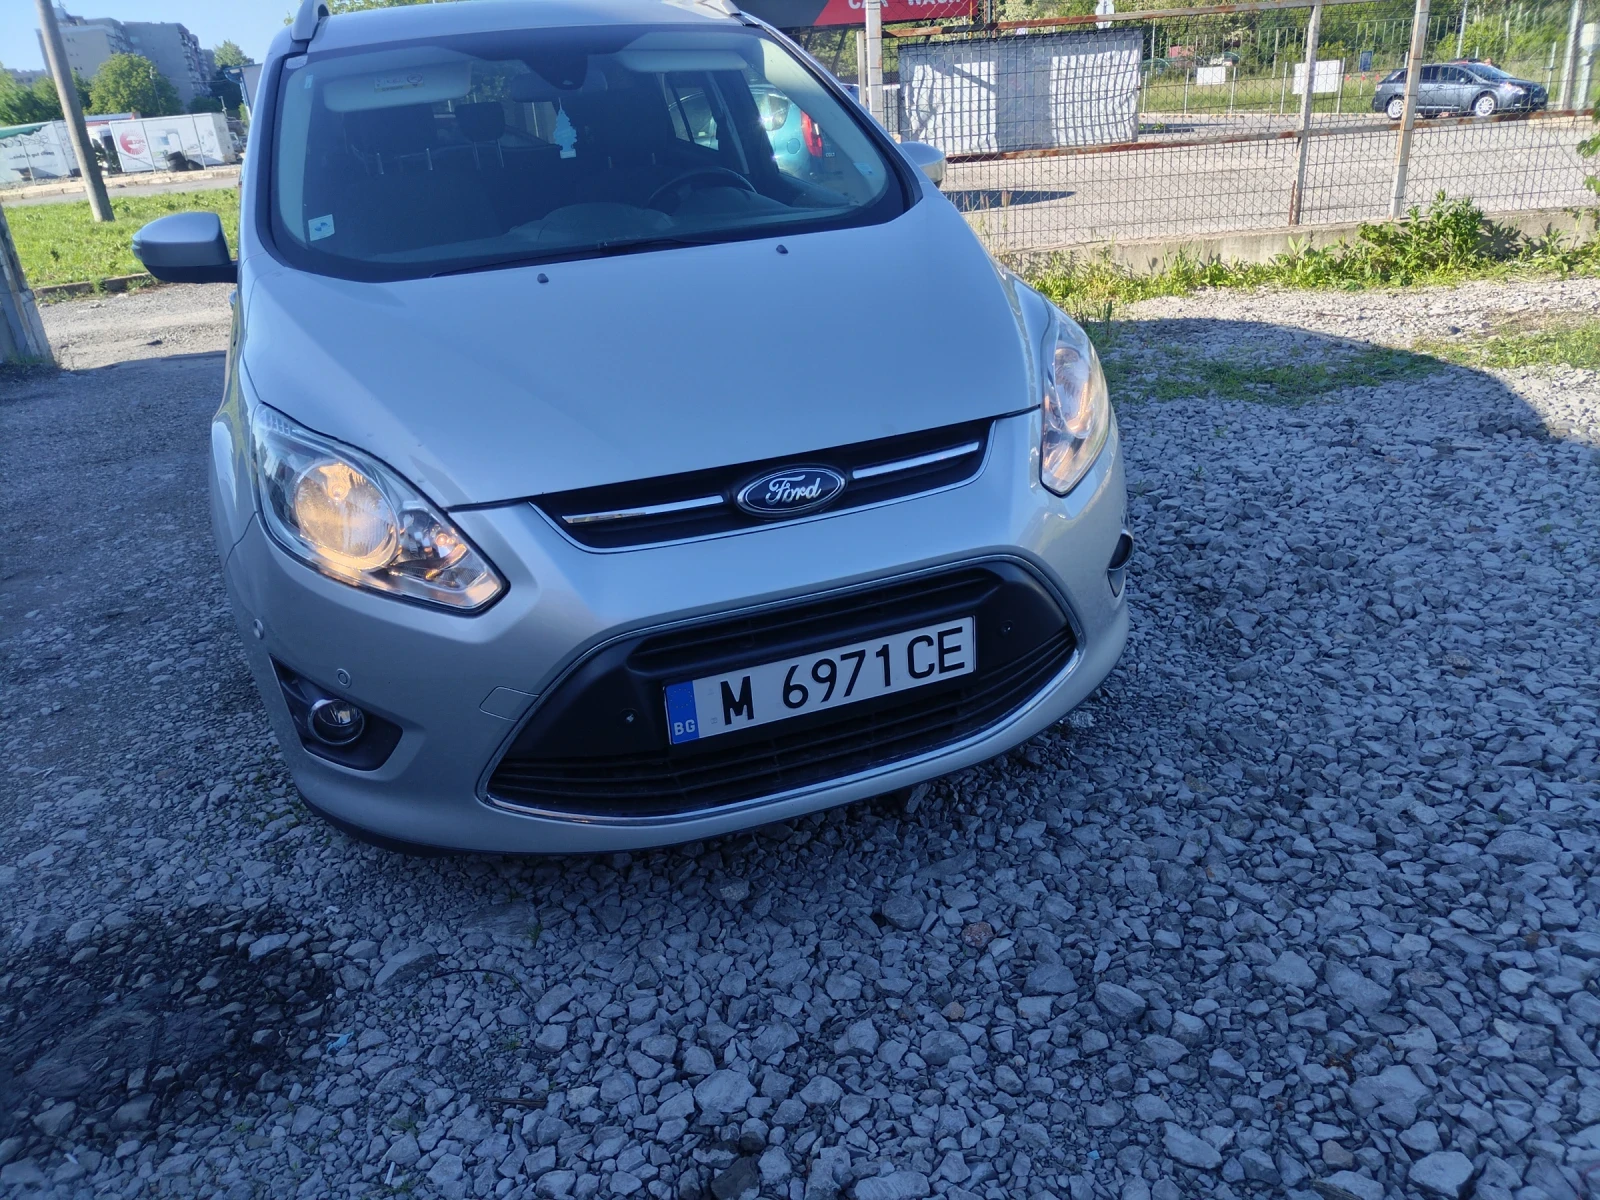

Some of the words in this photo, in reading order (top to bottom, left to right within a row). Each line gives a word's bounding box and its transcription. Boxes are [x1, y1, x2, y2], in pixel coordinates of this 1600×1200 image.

[765, 474, 822, 505] Ford
[720, 675, 755, 725] M
[782, 643, 891, 709] 6971
[673, 719, 696, 736] BG
